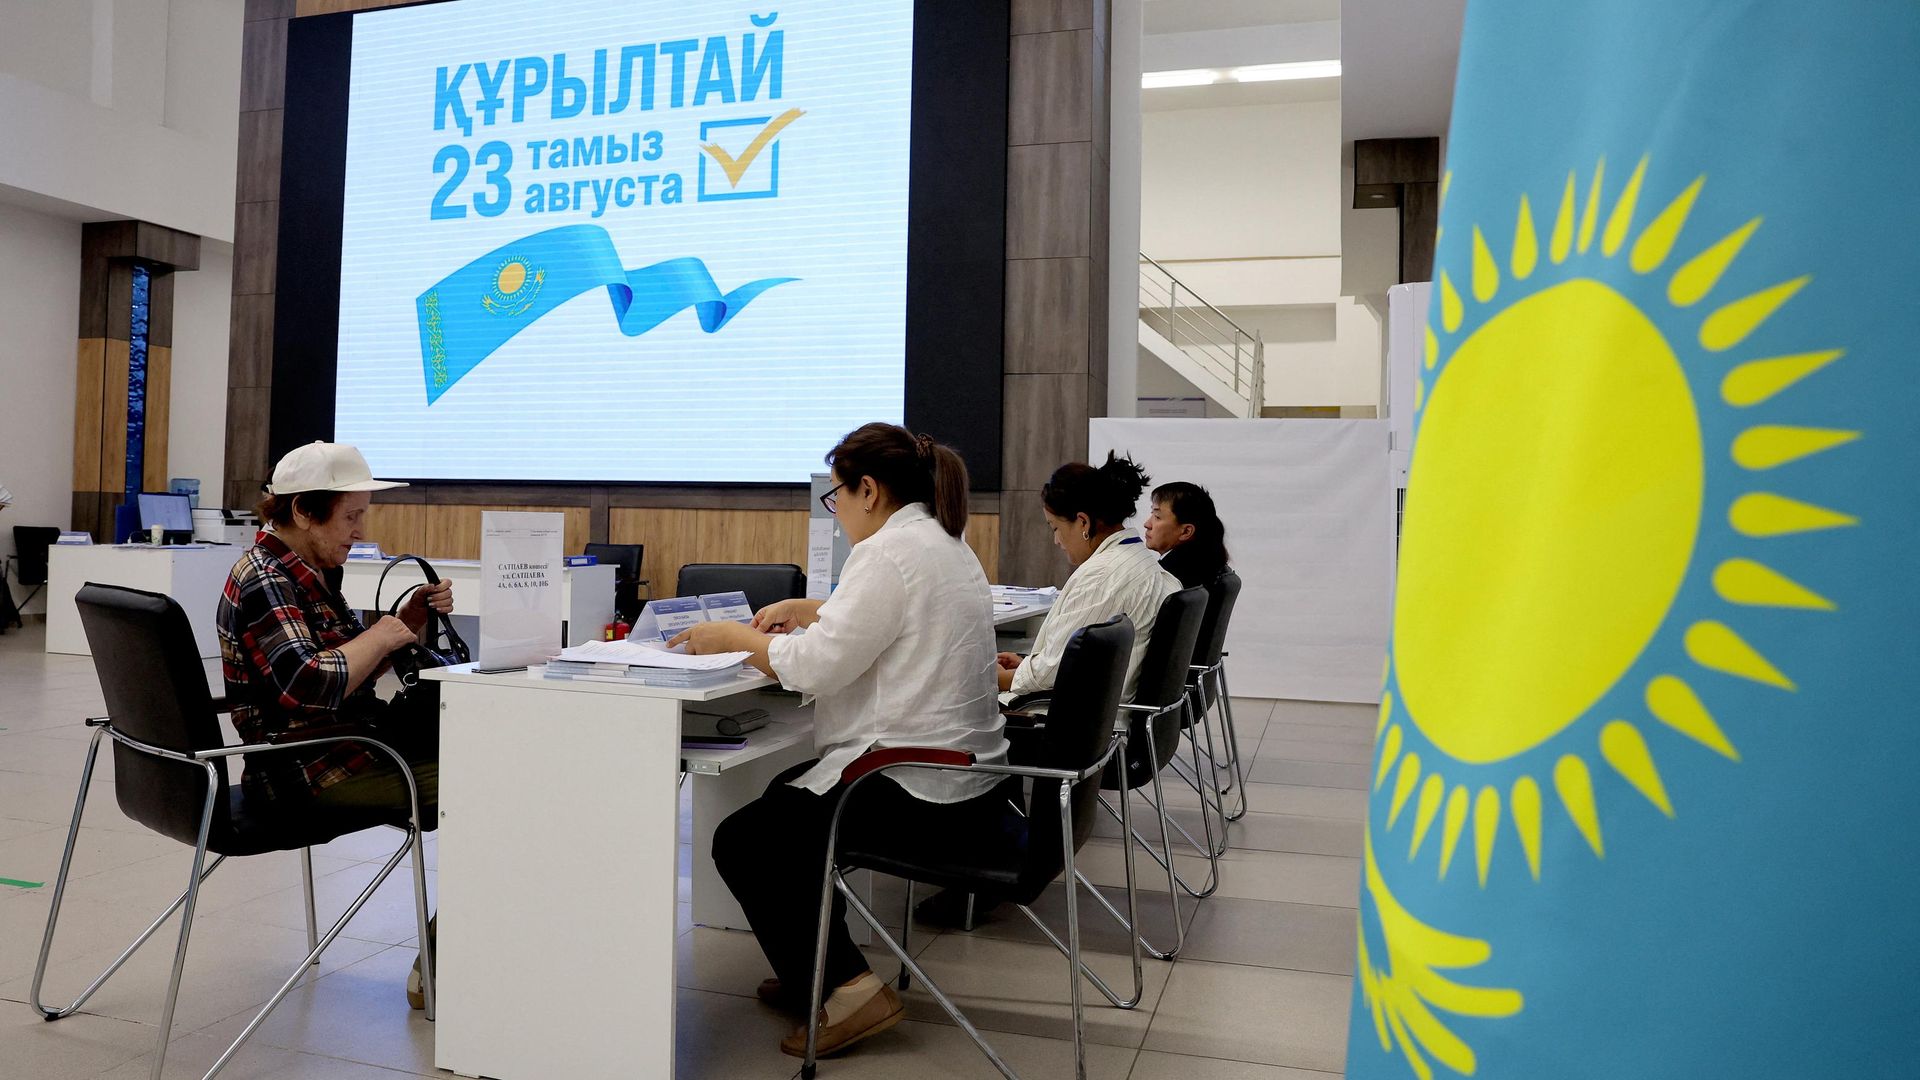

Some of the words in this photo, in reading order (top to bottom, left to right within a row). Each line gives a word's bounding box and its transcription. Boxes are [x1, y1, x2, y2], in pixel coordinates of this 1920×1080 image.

[433, 12, 784, 137] ҚҰРЫЛТАЙ
[526, 130, 664, 170] тамыз
[430, 140, 513, 220] 23
[524, 171, 682, 218] августа
[498, 563, 528, 571] САТПАЕВ
